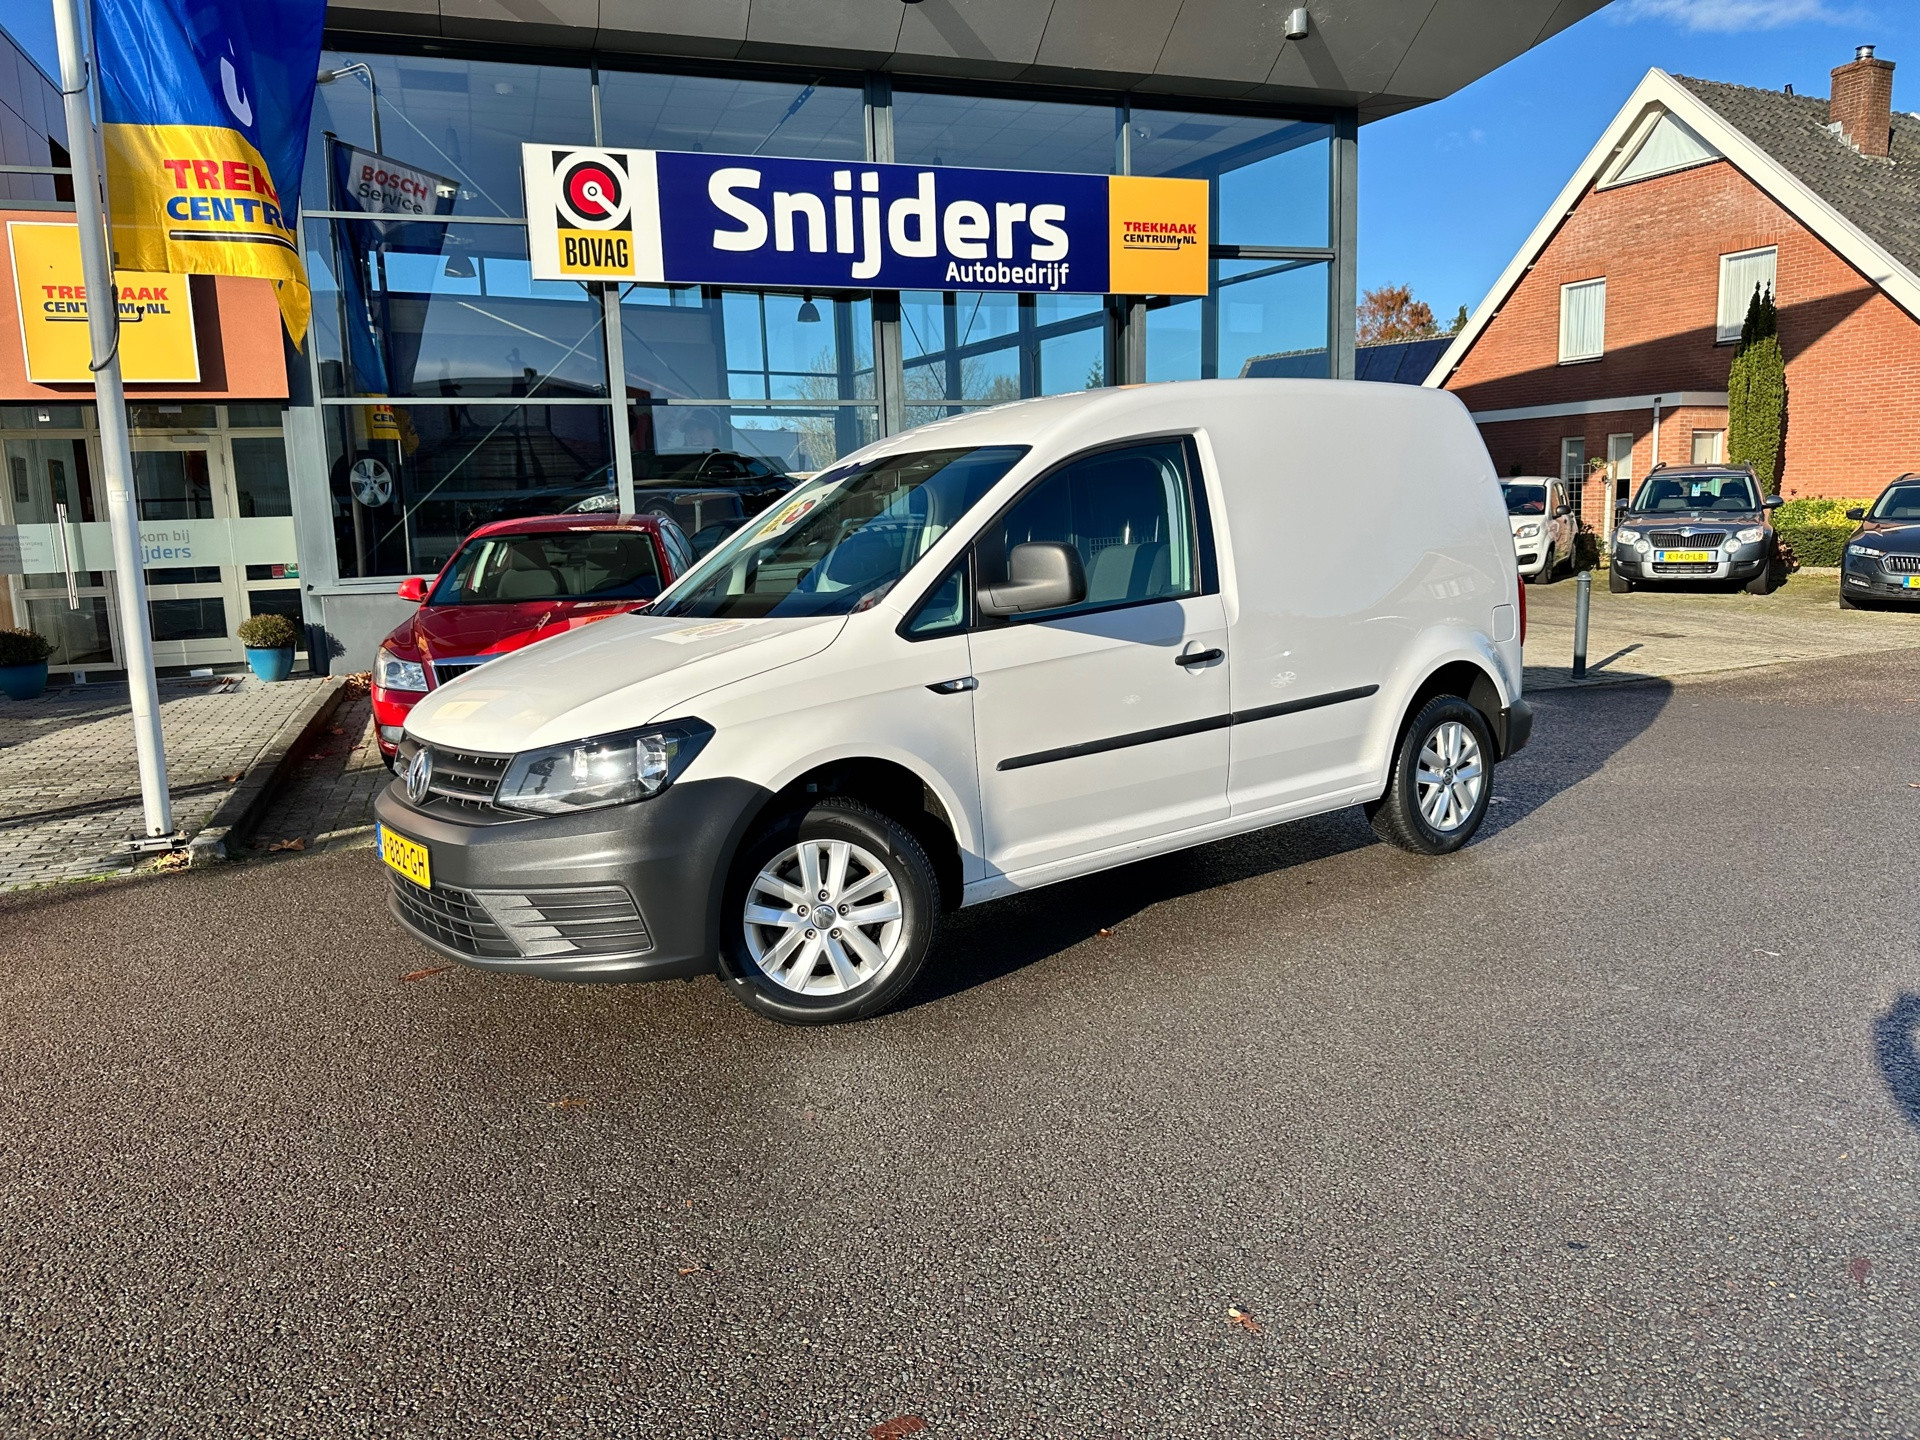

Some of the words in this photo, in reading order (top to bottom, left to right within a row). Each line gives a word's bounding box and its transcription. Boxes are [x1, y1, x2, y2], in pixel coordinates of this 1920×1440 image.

[361, 165, 428, 201] BOSCH
[357, 183, 423, 215] Service
[708, 167, 1069, 279] Snijders
[1123, 222, 1197, 234] TREKHAAK
[564, 236, 629, 268] BOVAG
[945, 261, 1069, 291] Autobedrijf
[42, 285, 169, 300] TREAAK
[173, 529, 190, 544] bij
